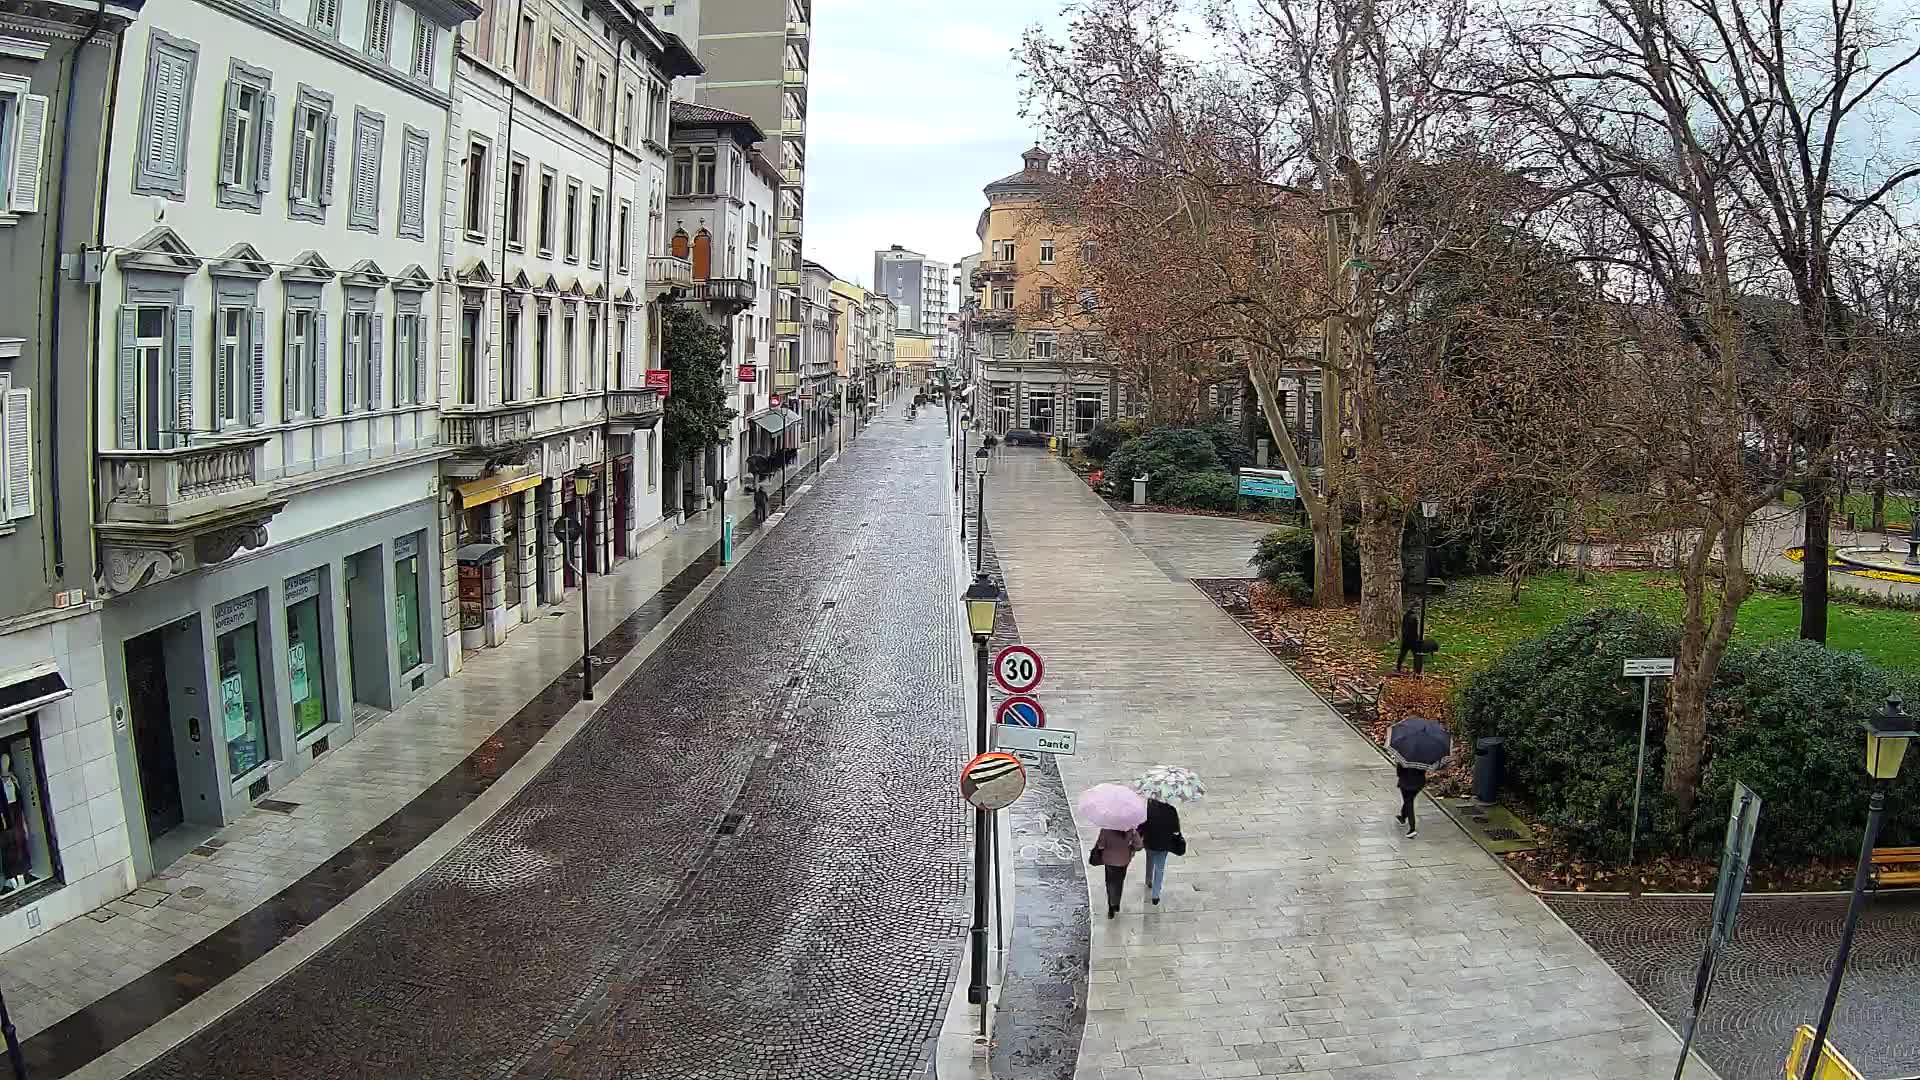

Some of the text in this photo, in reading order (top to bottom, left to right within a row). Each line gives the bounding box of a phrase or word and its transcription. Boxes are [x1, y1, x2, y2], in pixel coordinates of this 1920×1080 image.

[1006, 659, 1033, 680] 30
[222, 678, 241, 701] 130
[1039, 738, 1070, 750] Dante
